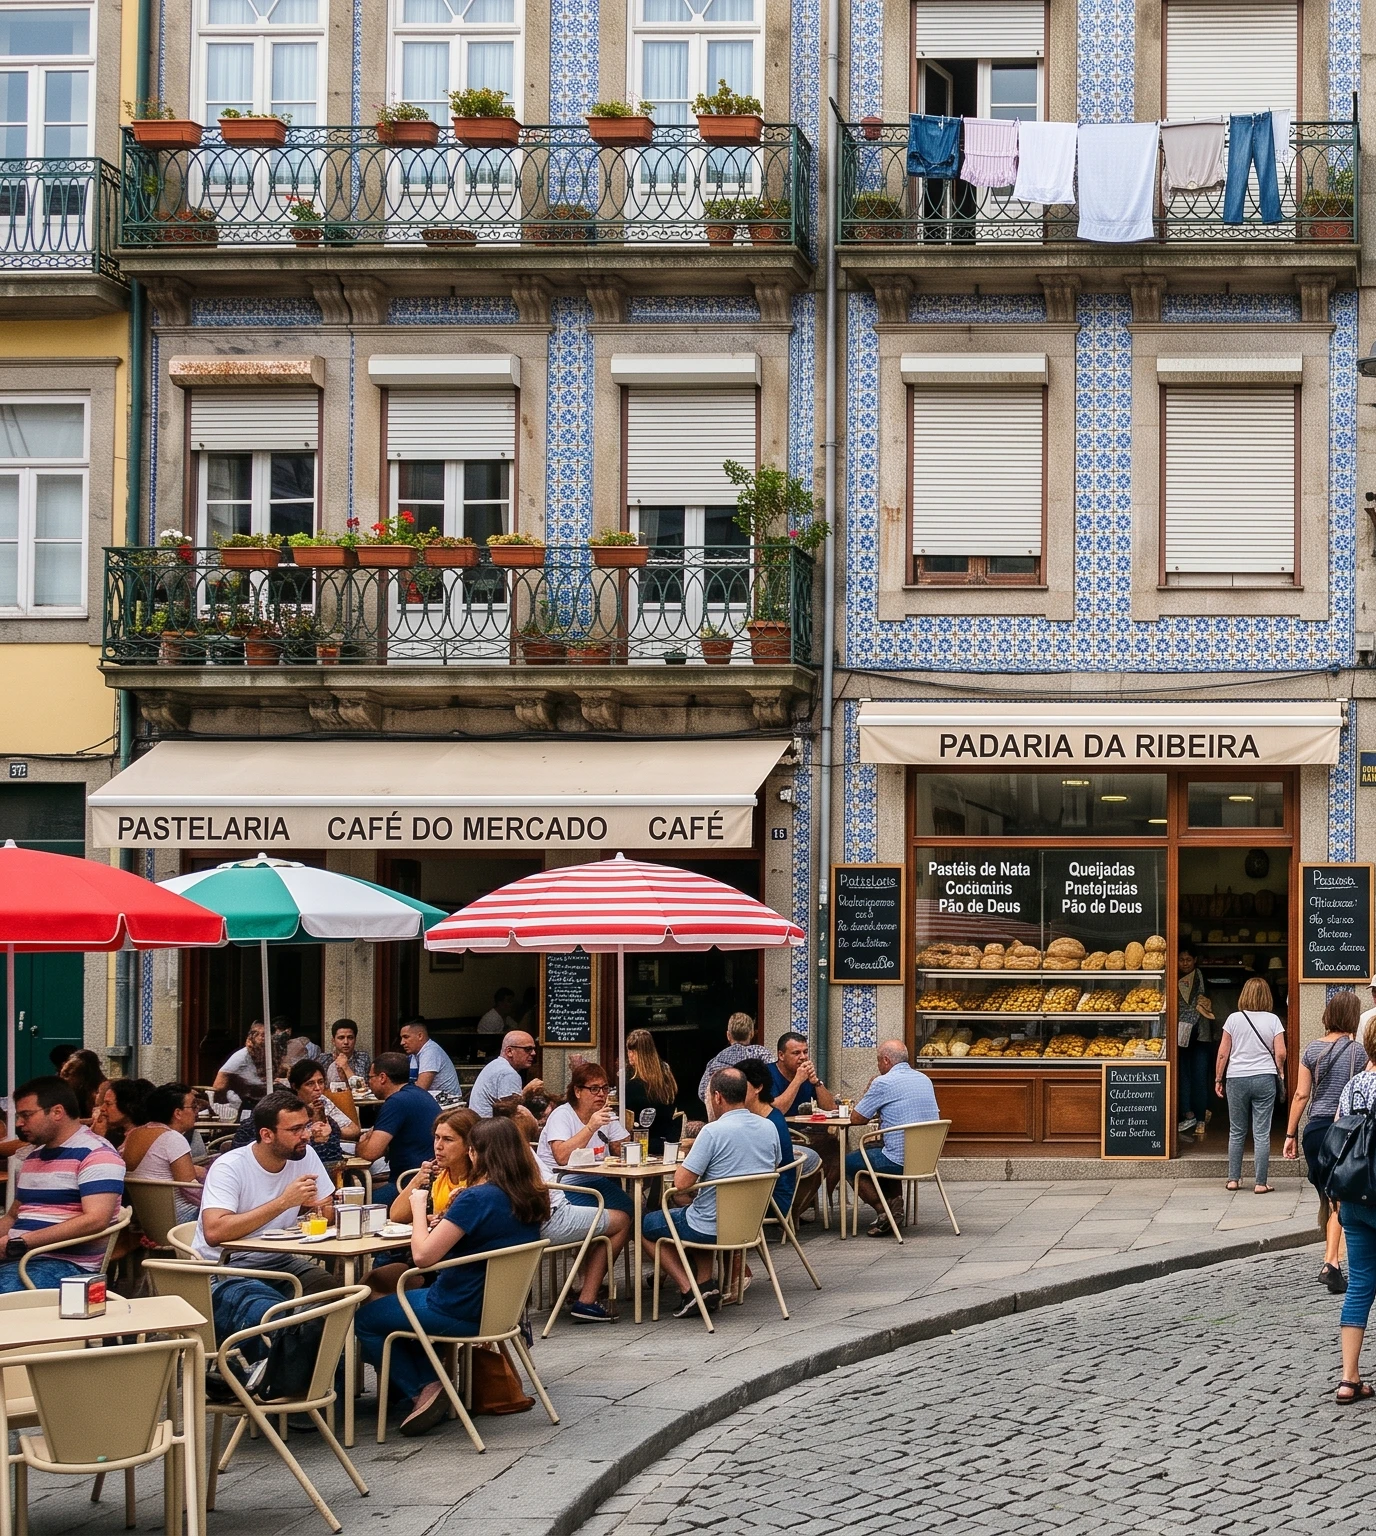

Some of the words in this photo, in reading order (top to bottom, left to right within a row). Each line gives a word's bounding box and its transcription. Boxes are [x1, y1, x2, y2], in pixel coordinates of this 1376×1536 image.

[940, 733, 1074, 759] PADARIA
[1084, 734, 1127, 759] DA
[1135, 734, 1260, 759] RIBEIRA
[117, 815, 291, 841] PASTELARIA
[327, 810, 403, 841] CAFÉ
[412, 815, 454, 841] DO
[463, 815, 608, 841] MERCADO
[648, 809, 724, 841] CAFÉ
[928, 861, 977, 877] Pastéis
[979, 861, 997, 877] de
[1000, 861, 1031, 877] Nata
[1068, 861, 1136, 880] Queijadas
[938, 899, 964, 913] Pão
[967, 899, 984, 913] de
[987, 899, 1021, 913] Deus
[1061, 898, 1087, 913] Pão
[1090, 898, 1106, 913] de
[1109, 899, 1143, 914] Deus
